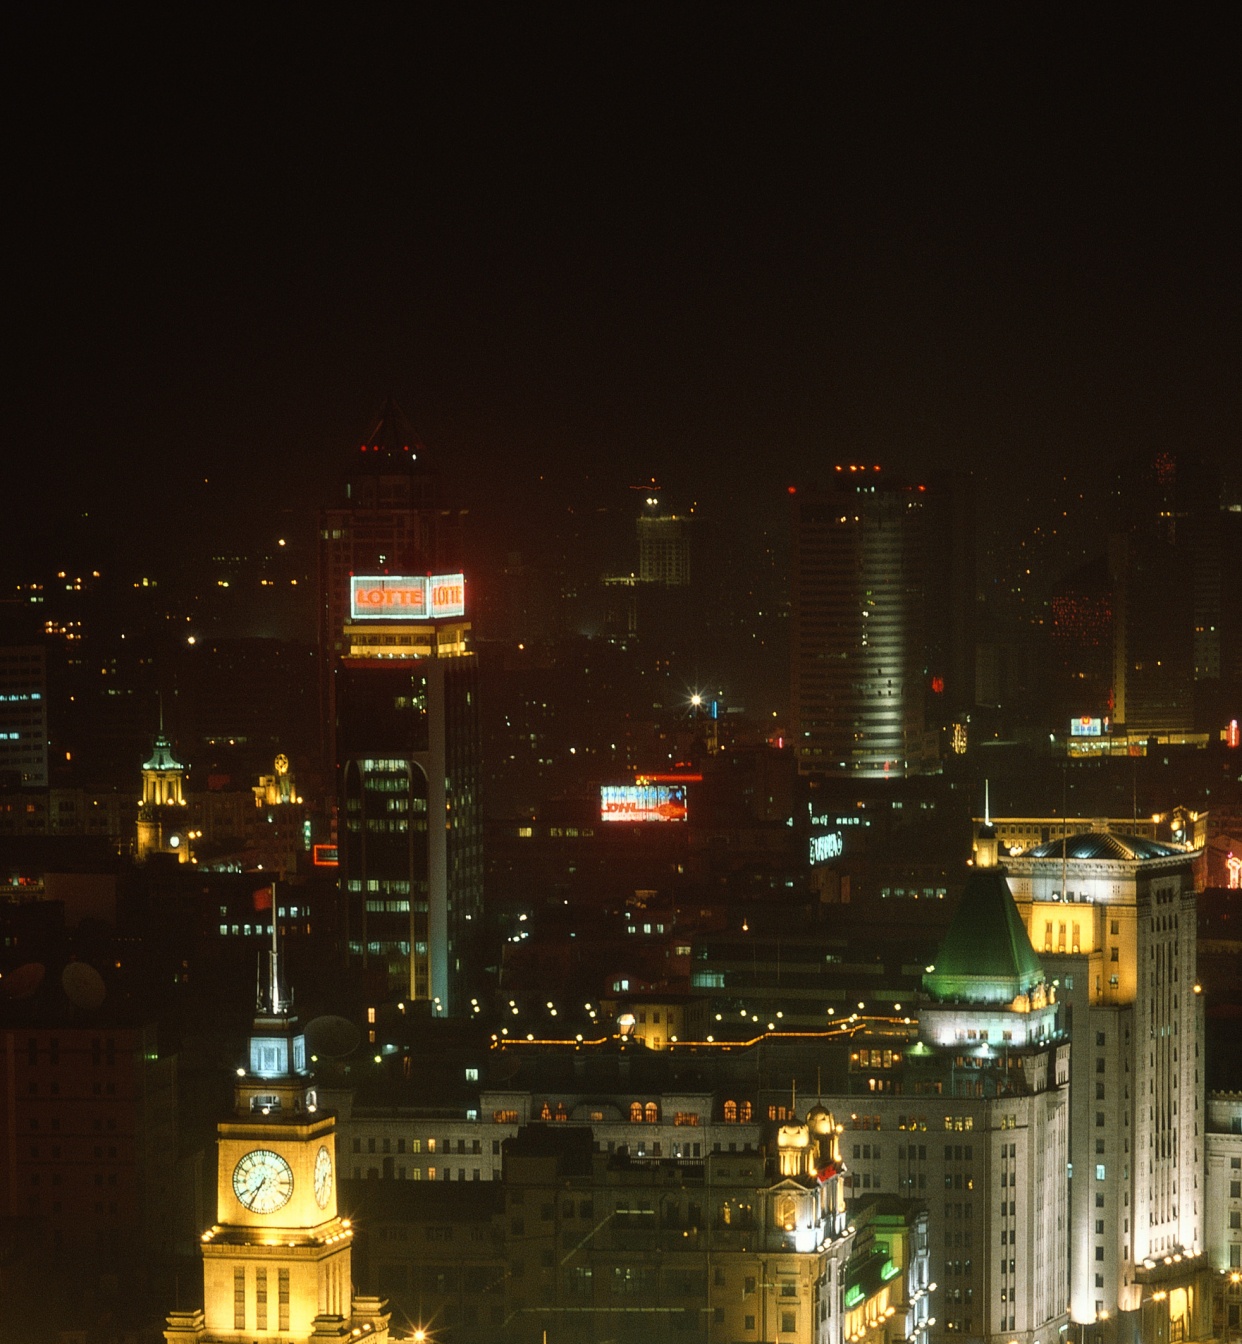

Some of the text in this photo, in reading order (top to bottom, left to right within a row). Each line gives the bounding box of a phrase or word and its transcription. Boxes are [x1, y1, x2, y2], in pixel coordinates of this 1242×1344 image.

[357, 588, 423, 605] LOTTE
[433, 585, 462, 606] LOTTE
[606, 803, 637, 813] DHL
